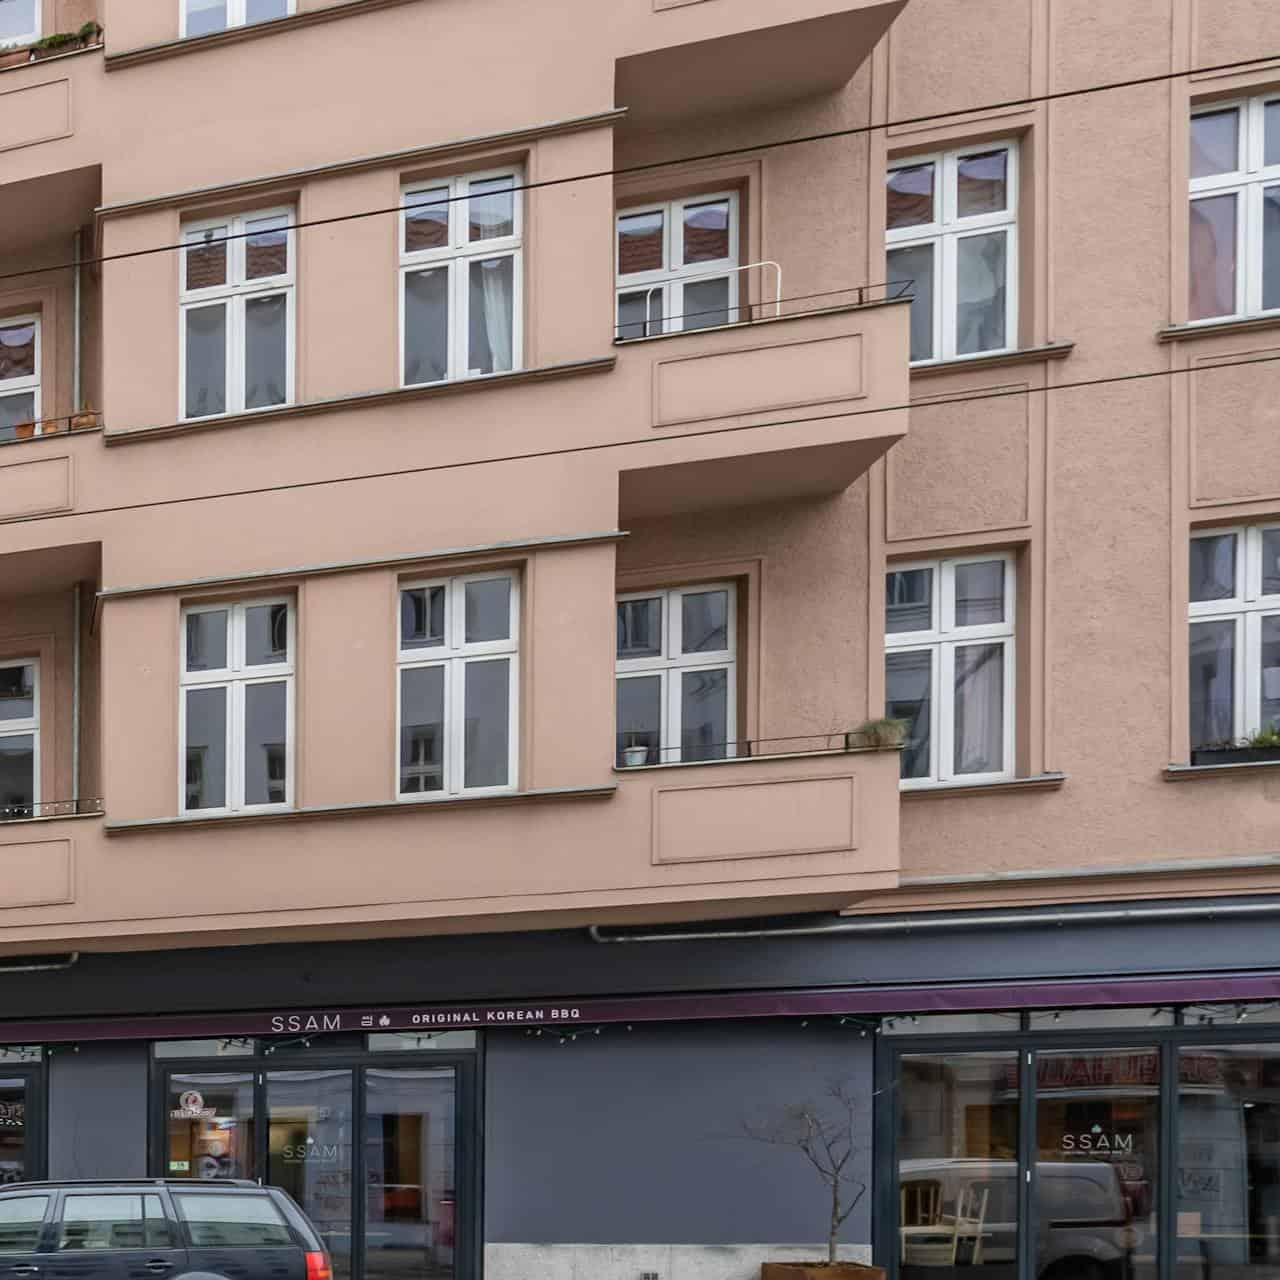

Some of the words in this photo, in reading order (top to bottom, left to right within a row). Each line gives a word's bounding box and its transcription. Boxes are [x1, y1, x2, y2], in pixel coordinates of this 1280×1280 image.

[271, 1014, 340, 1032] SSAM
[411, 1012, 480, 1024] ORIGINAL
[487, 1009, 544, 1022] KOREAN
[550, 1008, 581, 1019] BBQ
[1062, 1133, 1133, 1150] SSAM
[283, 1145, 337, 1158] SSAM
